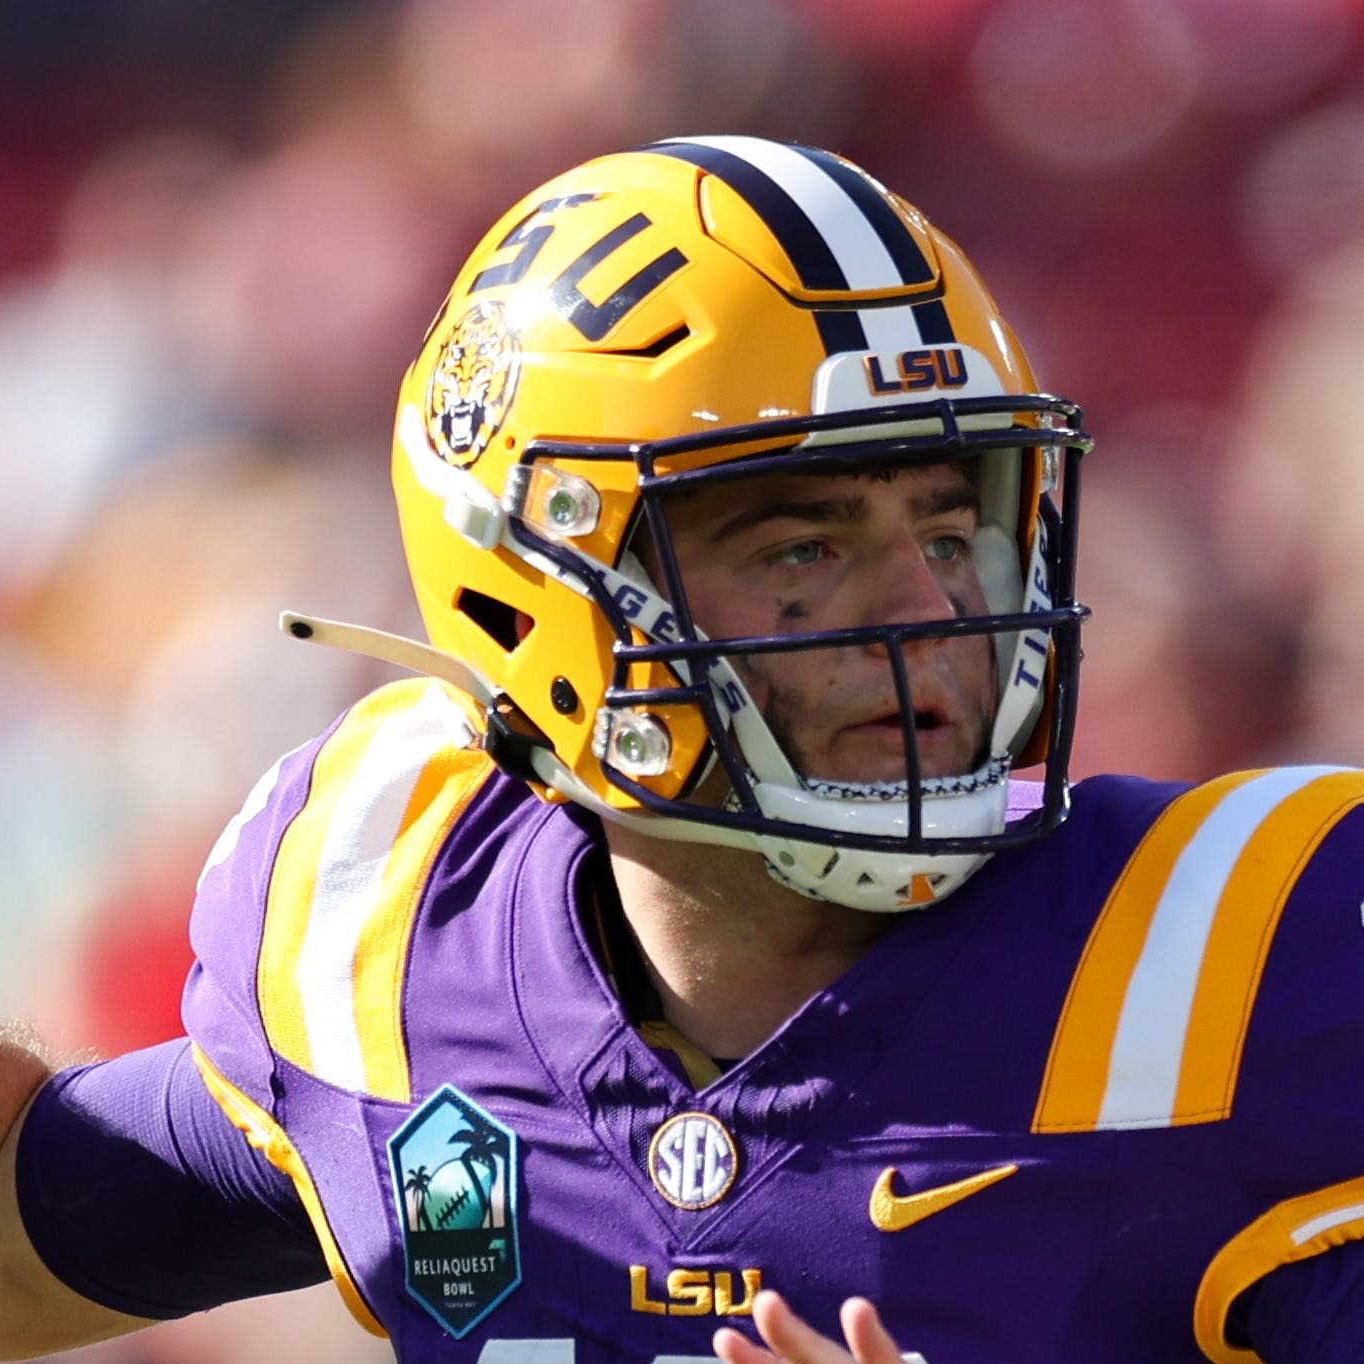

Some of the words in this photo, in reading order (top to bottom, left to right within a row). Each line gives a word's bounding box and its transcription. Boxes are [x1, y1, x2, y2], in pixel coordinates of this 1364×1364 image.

[862, 349, 968, 397] LSU
[658, 1120, 728, 1201] SEC
[414, 1257, 496, 1277] RELIAQUEST
[443, 1283, 475, 1297] BOWL
[629, 1264, 761, 1316] LSU
